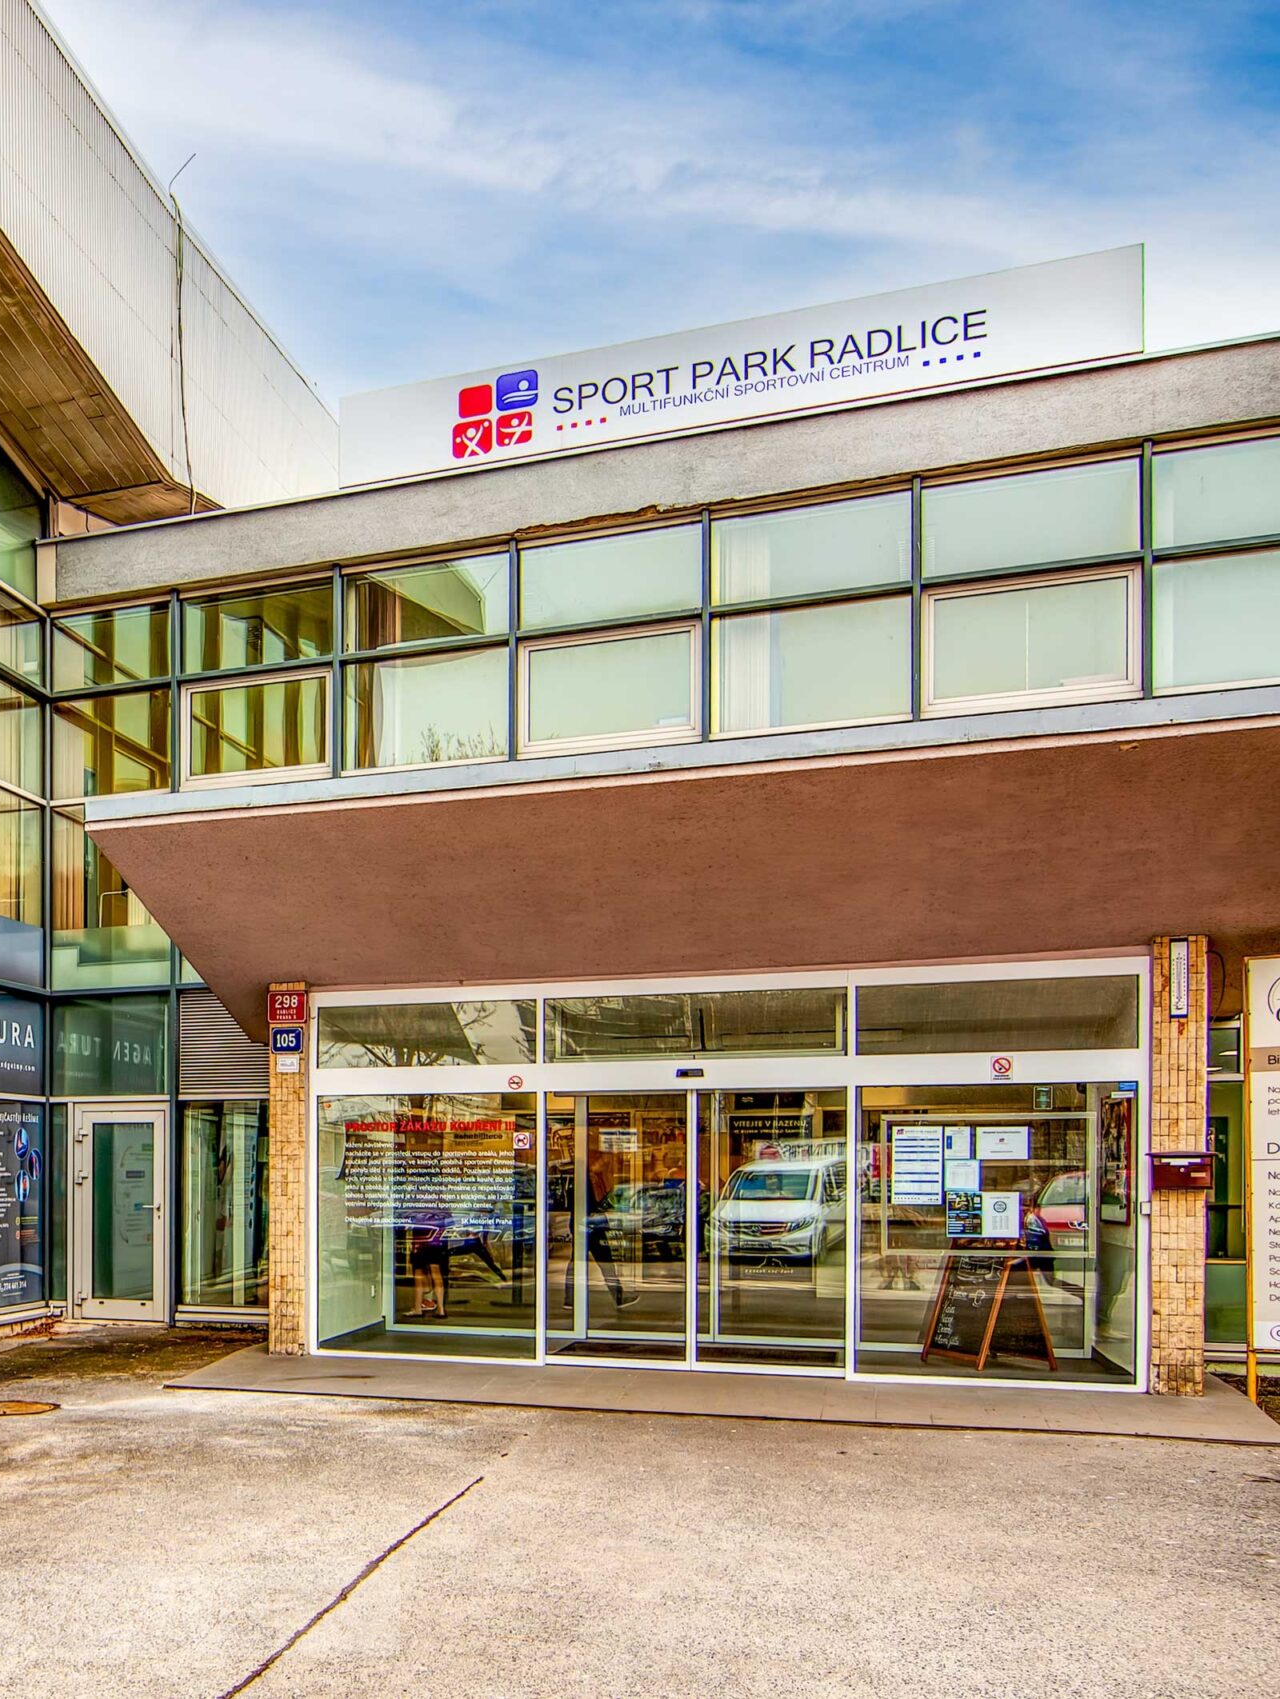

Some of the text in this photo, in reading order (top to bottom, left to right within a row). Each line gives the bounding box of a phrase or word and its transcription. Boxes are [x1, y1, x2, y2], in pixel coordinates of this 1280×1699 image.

[553, 309, 987, 414] SPORT PARK RADLICE
[619, 355, 910, 417] MULTIFUNKČNÍ SPORTOVNÍ CENTRUM
[275, 995, 298, 1008] 298
[276, 1033, 296, 1048] 105
[345, 1122, 397, 1133] PROSTOR
[399, 1120, 447, 1132] ZÁKAZU
[450, 1120, 503, 1132] KOUŘENÍ
